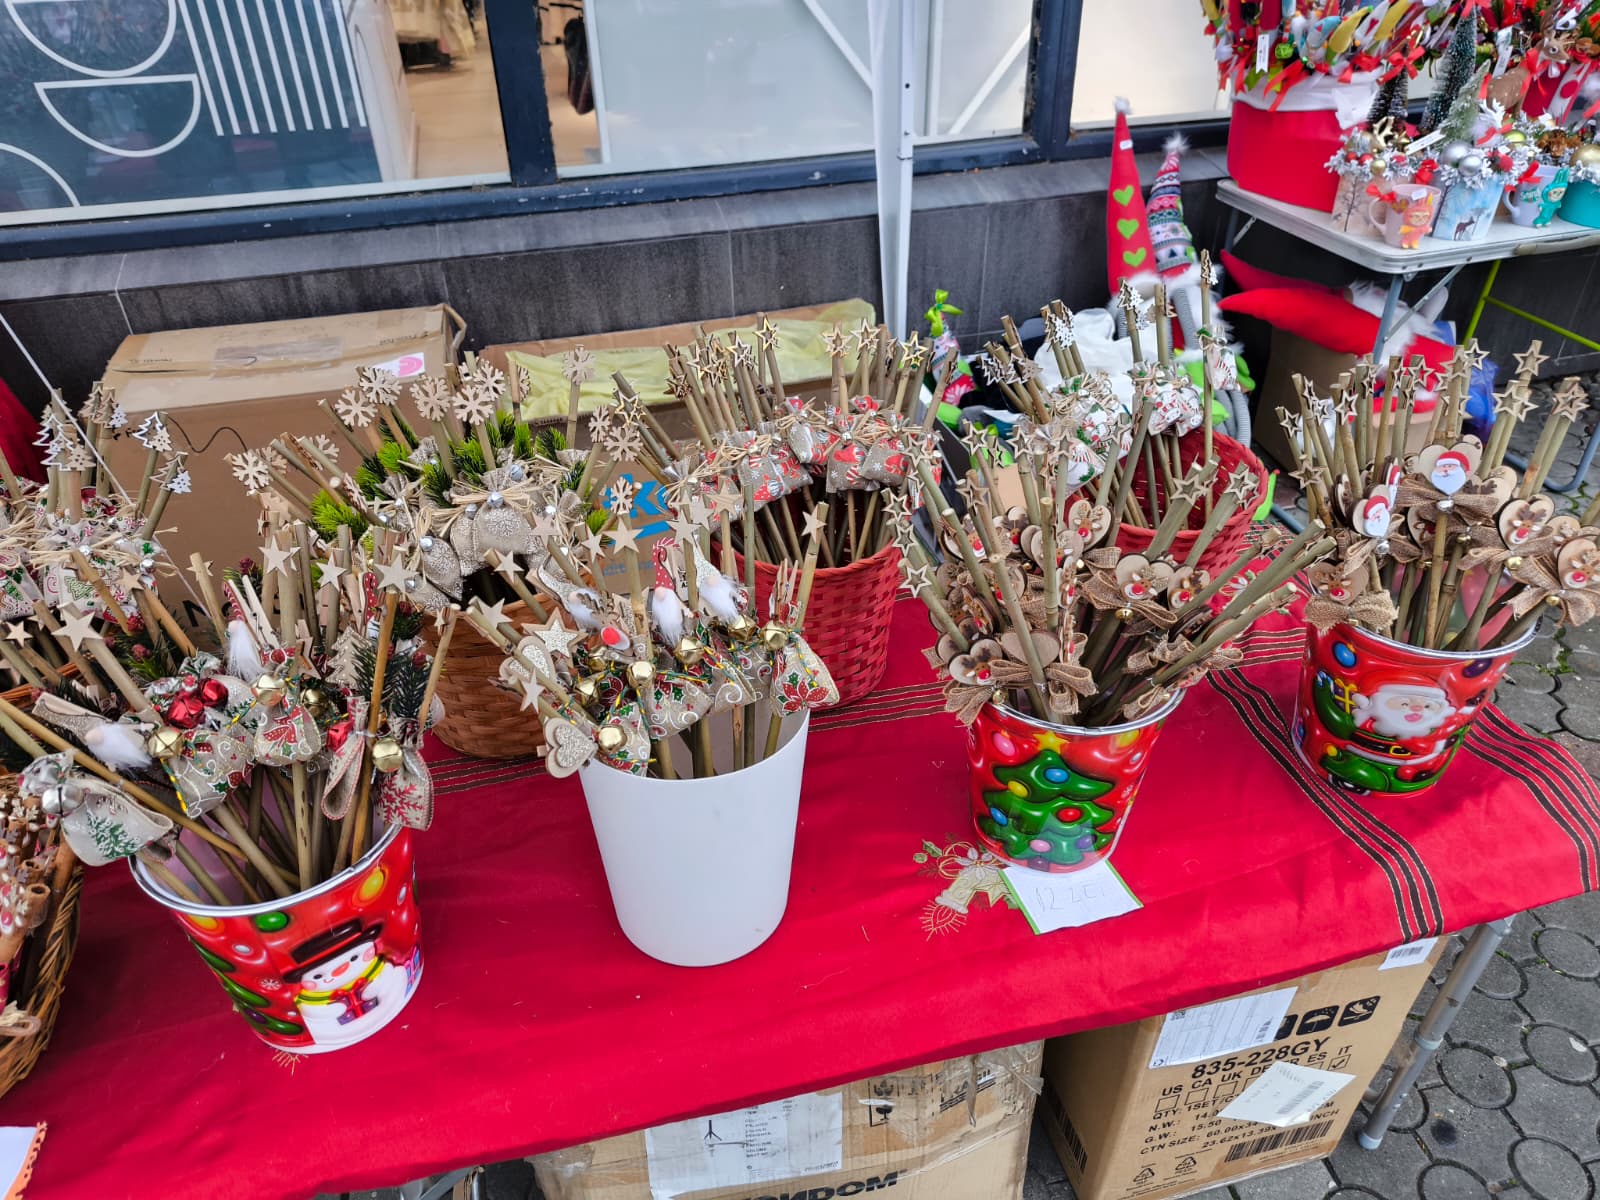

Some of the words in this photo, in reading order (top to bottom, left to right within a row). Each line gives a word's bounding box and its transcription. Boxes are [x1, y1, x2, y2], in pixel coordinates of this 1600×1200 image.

[1191, 1036, 1331, 1079] 835-228GY
[1161, 1084, 1184, 1097] US
[1191, 1077, 1213, 1090] CA
[1221, 1070, 1243, 1083] UK
[1307, 1051, 1328, 1063] ES
[1338, 1045, 1353, 1056] IT
[1152, 1109, 1182, 1121] QTY:
[1191, 1118, 1222, 1132] 15.50
[1139, 1142, 1166, 1155] CTN
